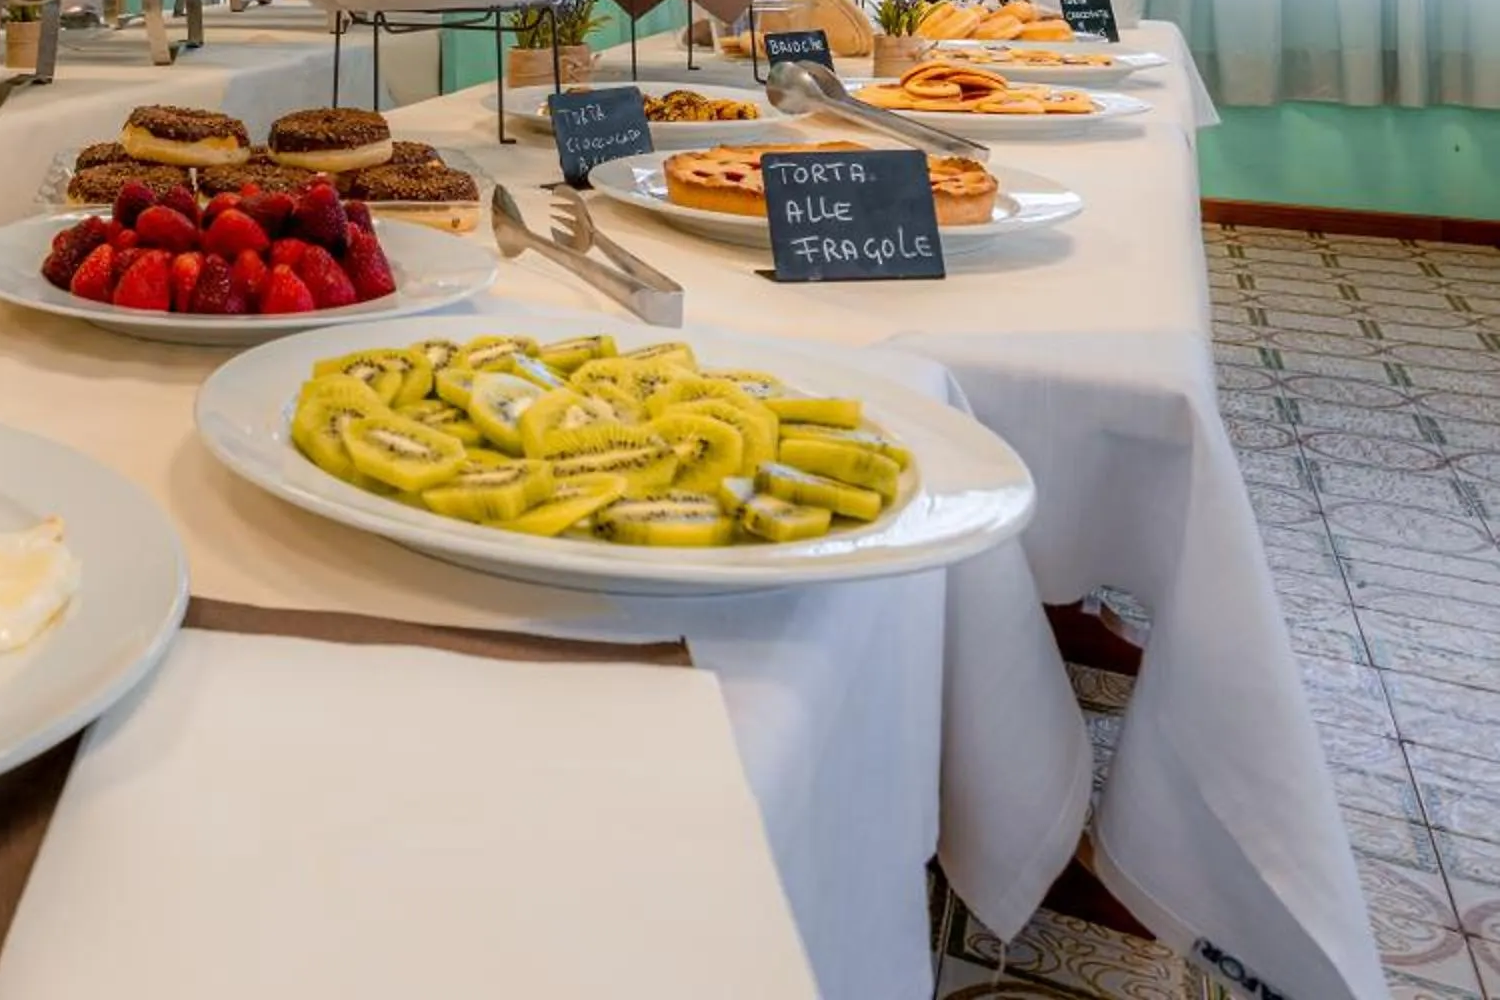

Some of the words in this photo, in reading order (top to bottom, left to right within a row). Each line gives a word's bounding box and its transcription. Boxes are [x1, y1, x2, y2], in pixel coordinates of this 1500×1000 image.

[768, 161, 866, 185] TORTA
[785, 196, 853, 224] ALLE
[790, 225, 933, 264] FRAGOLE
